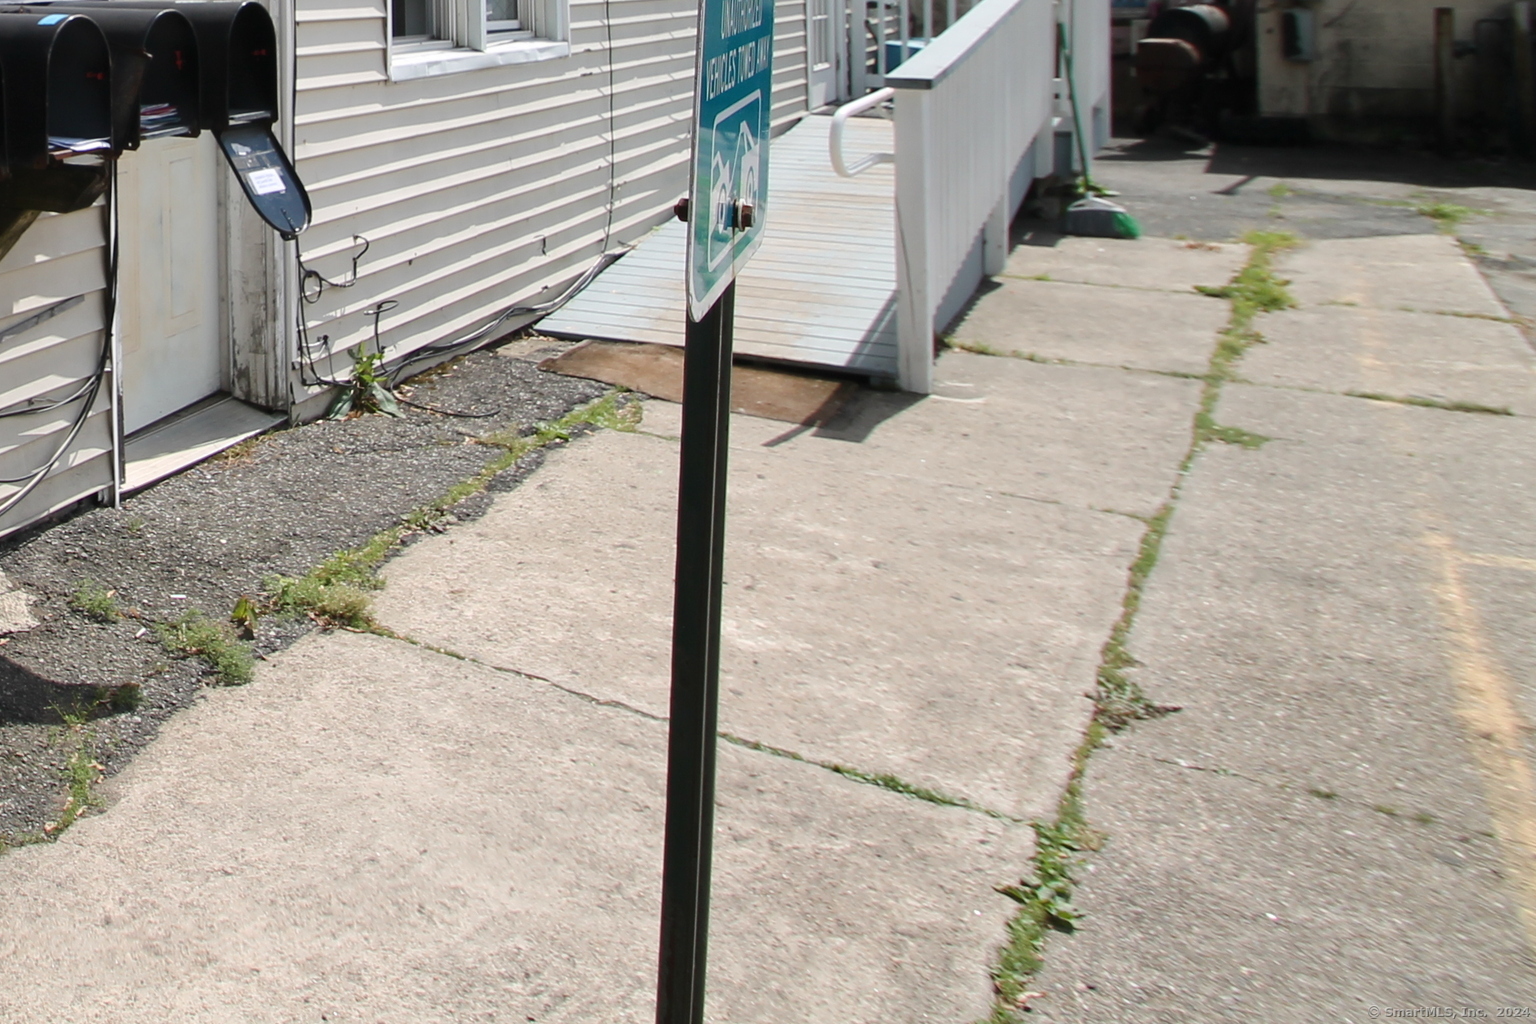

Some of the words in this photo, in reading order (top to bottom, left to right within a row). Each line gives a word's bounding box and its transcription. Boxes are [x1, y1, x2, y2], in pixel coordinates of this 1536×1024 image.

[706, 48, 736, 101] VEHICLES
[737, 41, 755, 84] TOWED
[756, 35, 770, 74] AWAY
